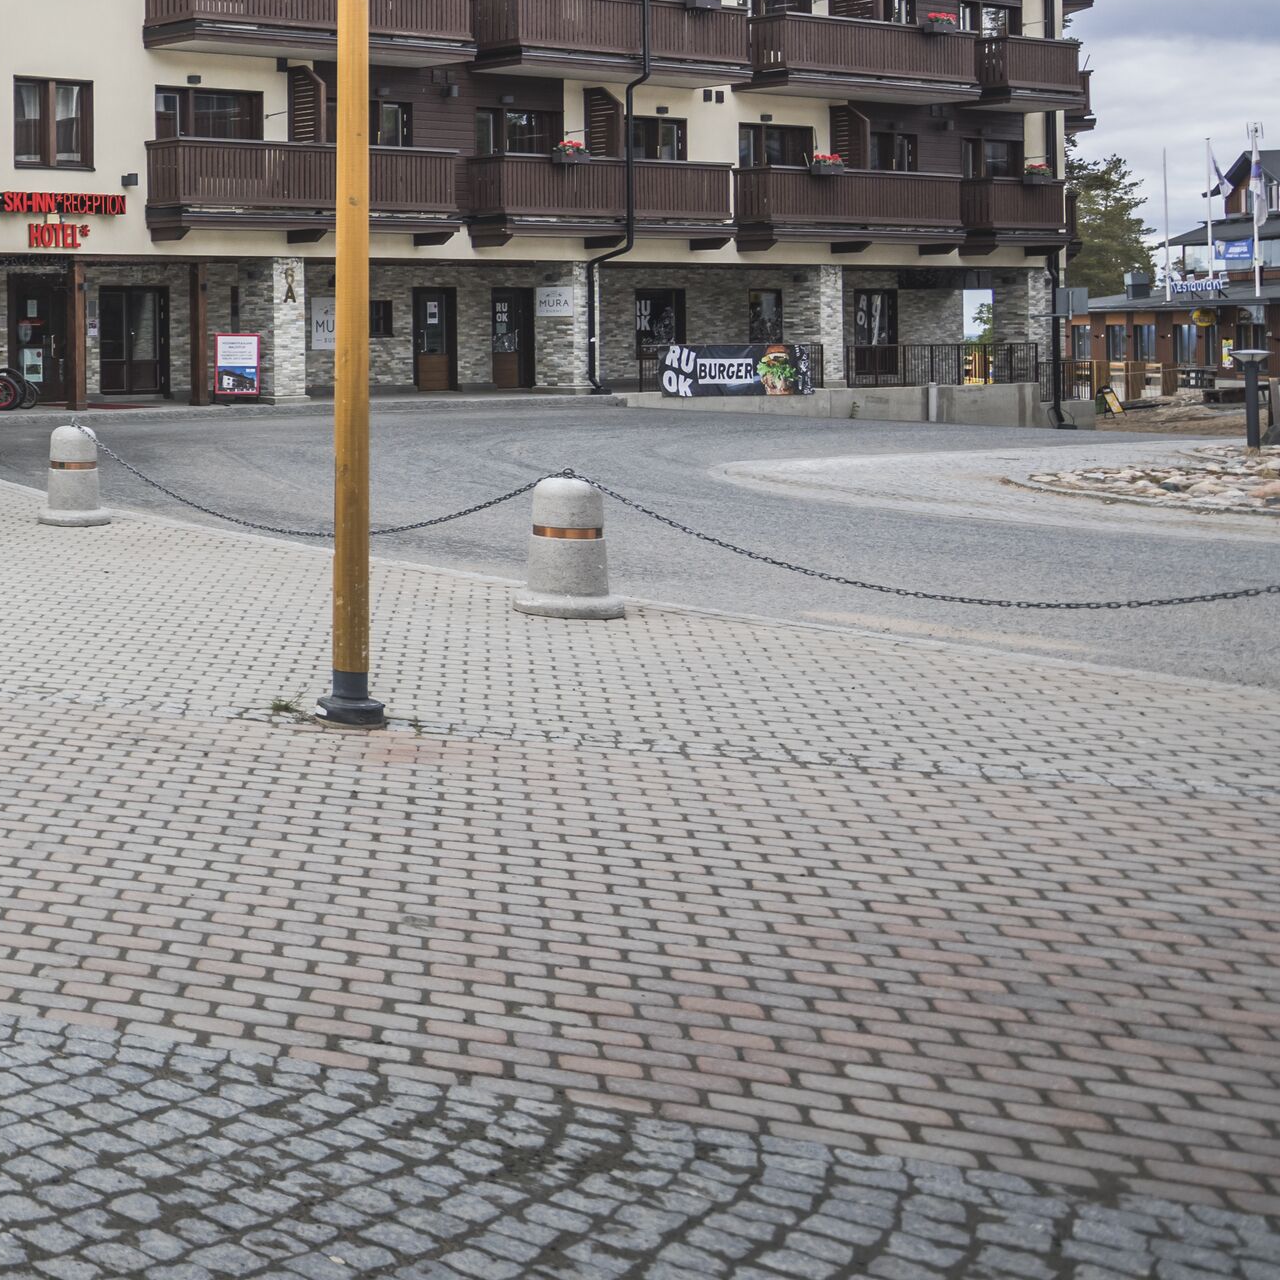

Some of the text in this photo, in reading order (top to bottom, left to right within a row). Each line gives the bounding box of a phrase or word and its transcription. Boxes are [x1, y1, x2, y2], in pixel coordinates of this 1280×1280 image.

[496, 302, 508, 312] RU
[539, 299, 570, 308] MURA
[496, 313, 508, 322] OK
[315, 319, 335, 333] MU
[665, 344, 696, 374] RU
[698, 363, 753, 380] BURGER
[663, 370, 693, 397] OK
